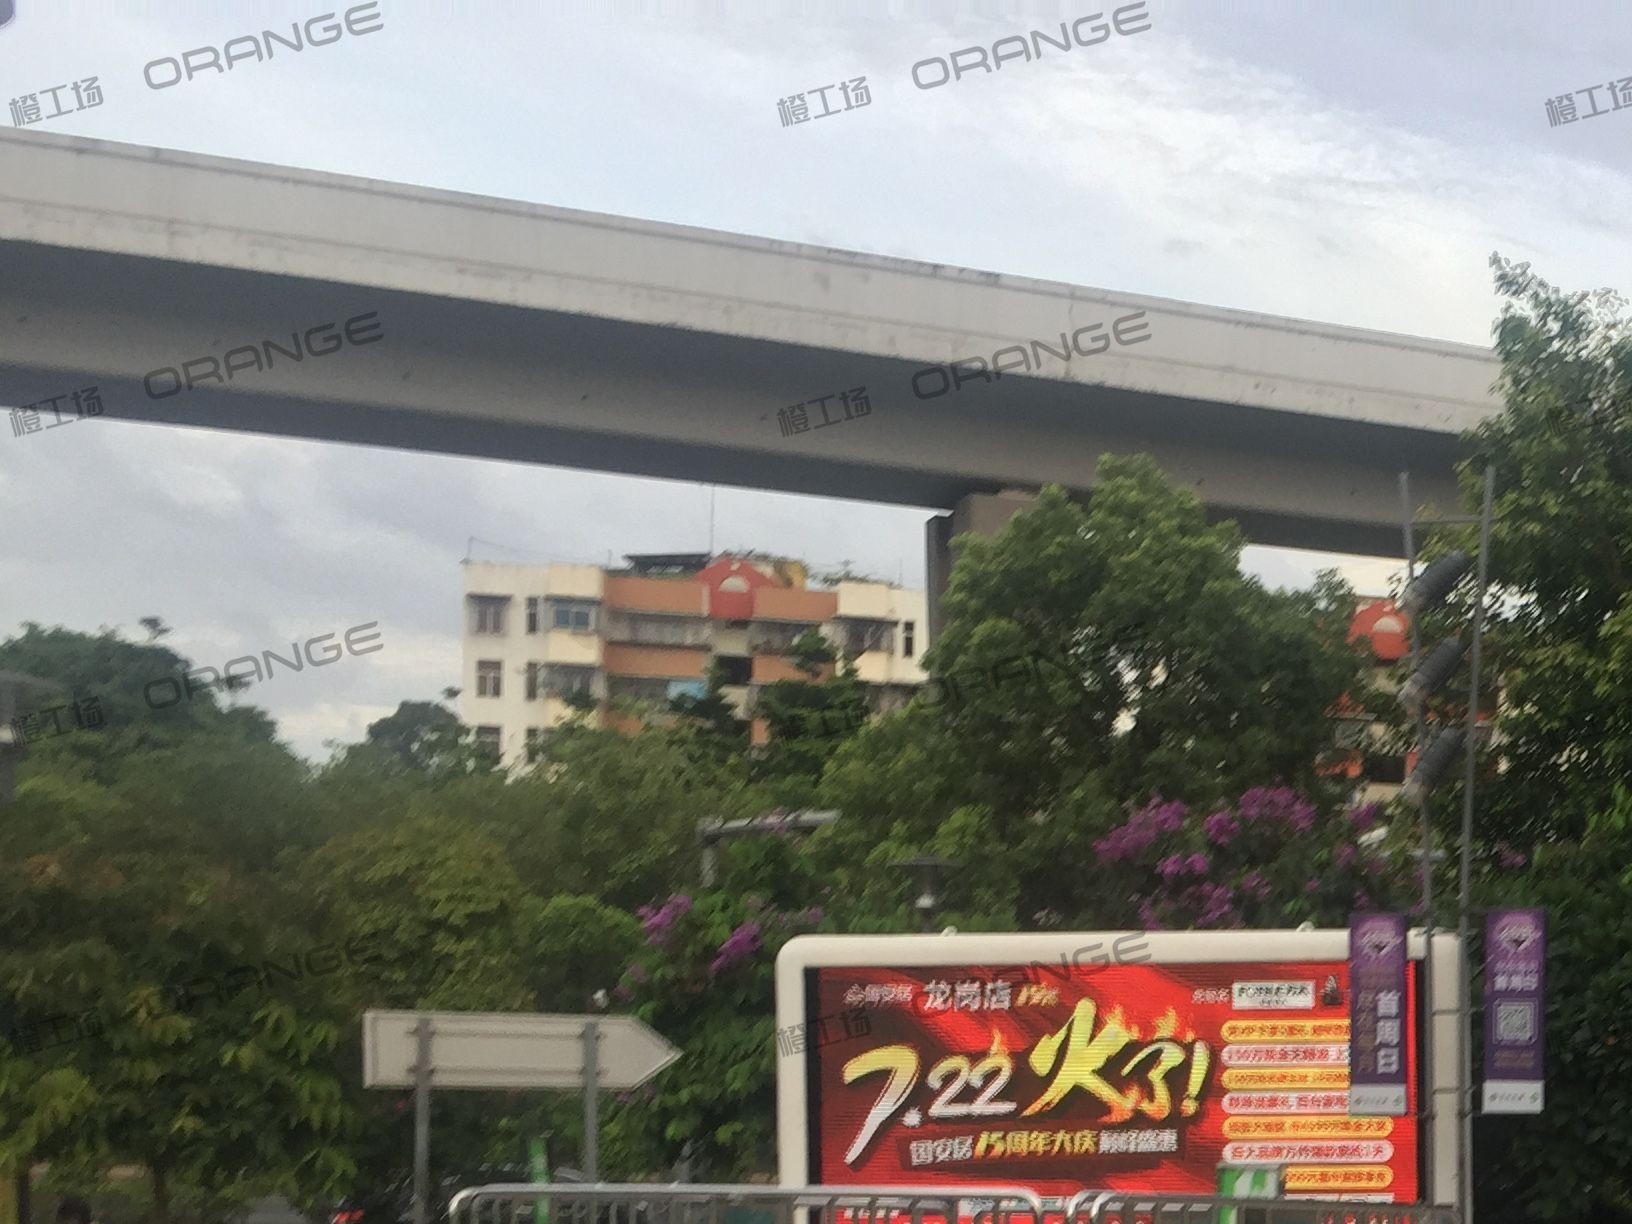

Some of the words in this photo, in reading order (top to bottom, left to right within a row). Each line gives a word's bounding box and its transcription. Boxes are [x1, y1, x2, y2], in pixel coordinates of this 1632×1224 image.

[923, 979, 1013, 1012] 龙岗店
[1376, 989, 1401, 1075] 首周日
